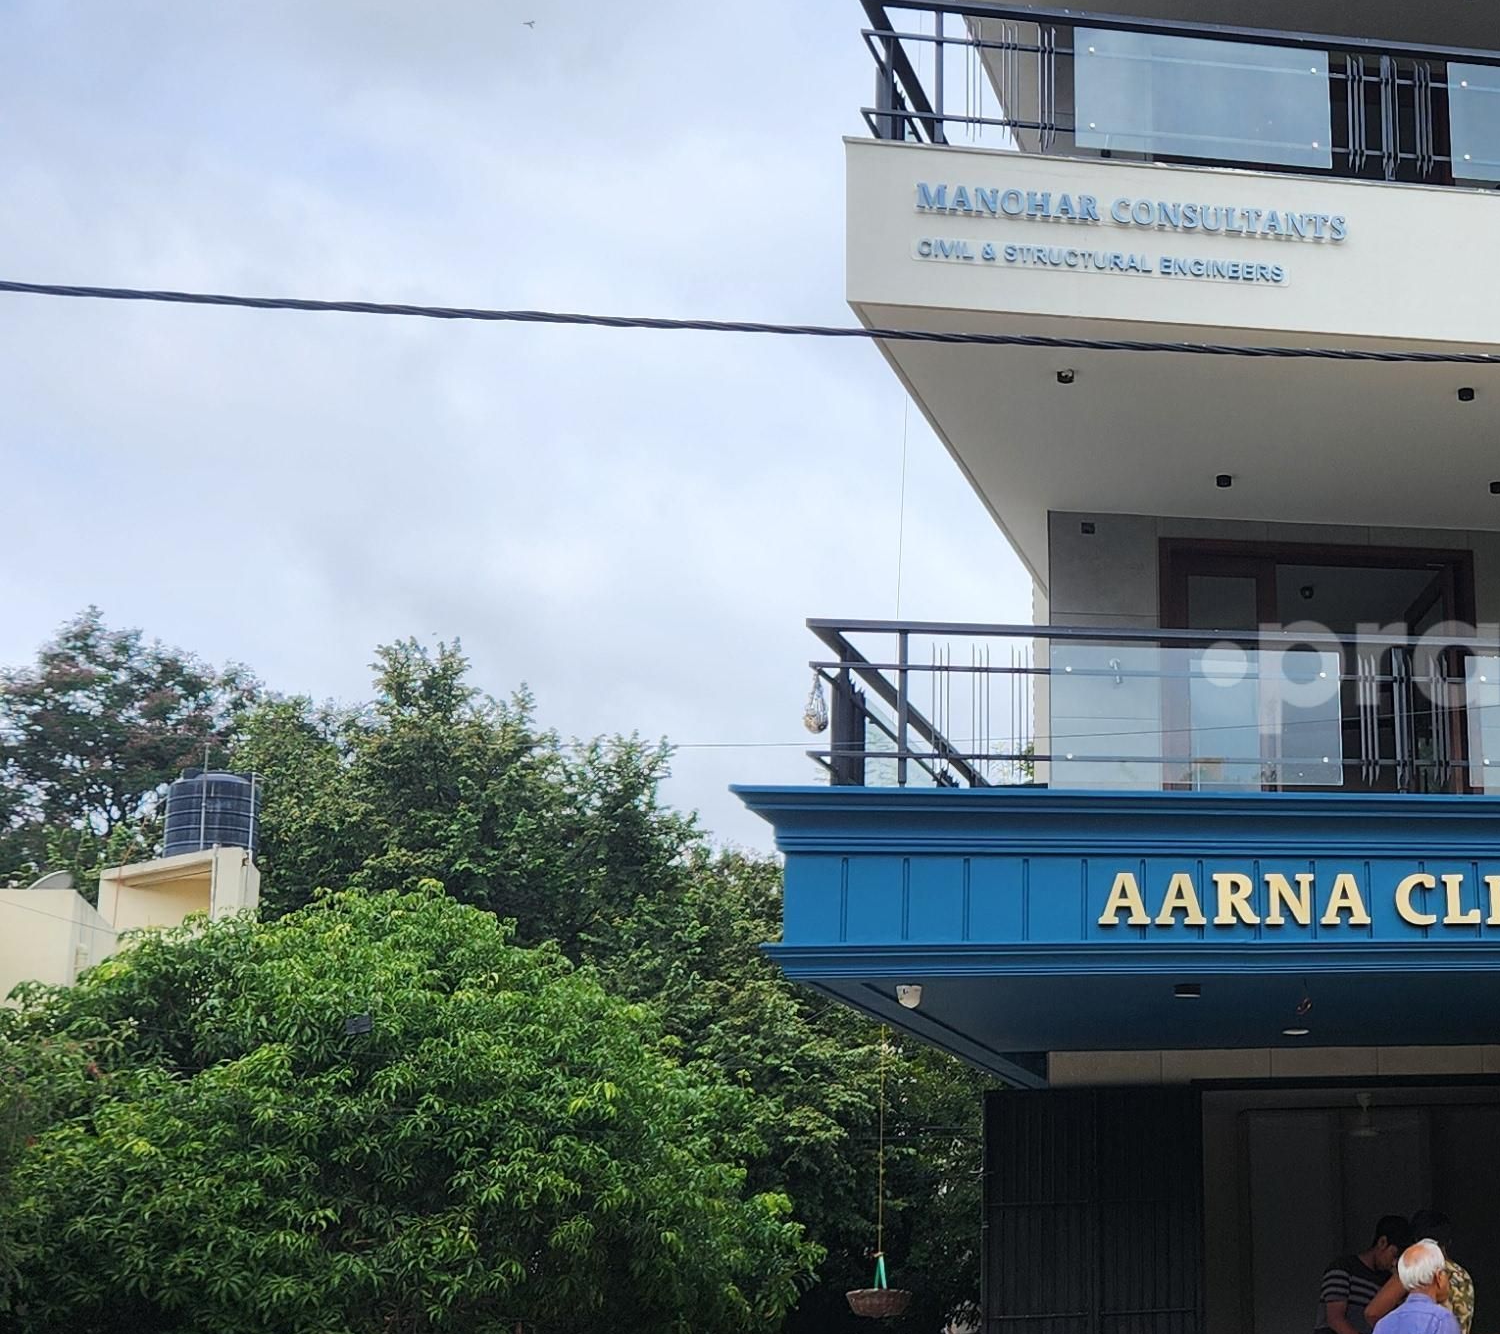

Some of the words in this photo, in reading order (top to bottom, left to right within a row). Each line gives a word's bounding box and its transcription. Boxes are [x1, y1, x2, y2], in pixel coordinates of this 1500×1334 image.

[916, 182, 1100, 221] MANOHAR
[1110, 197, 1348, 241] CONSULTANTS
[918, 239, 975, 260] CIVIL
[981, 243, 997, 261] &
[1003, 244, 1152, 273] STRUCTURAL
[1160, 256, 1284, 283] ENGINEERS
[1098, 873, 1371, 925] AARNA
